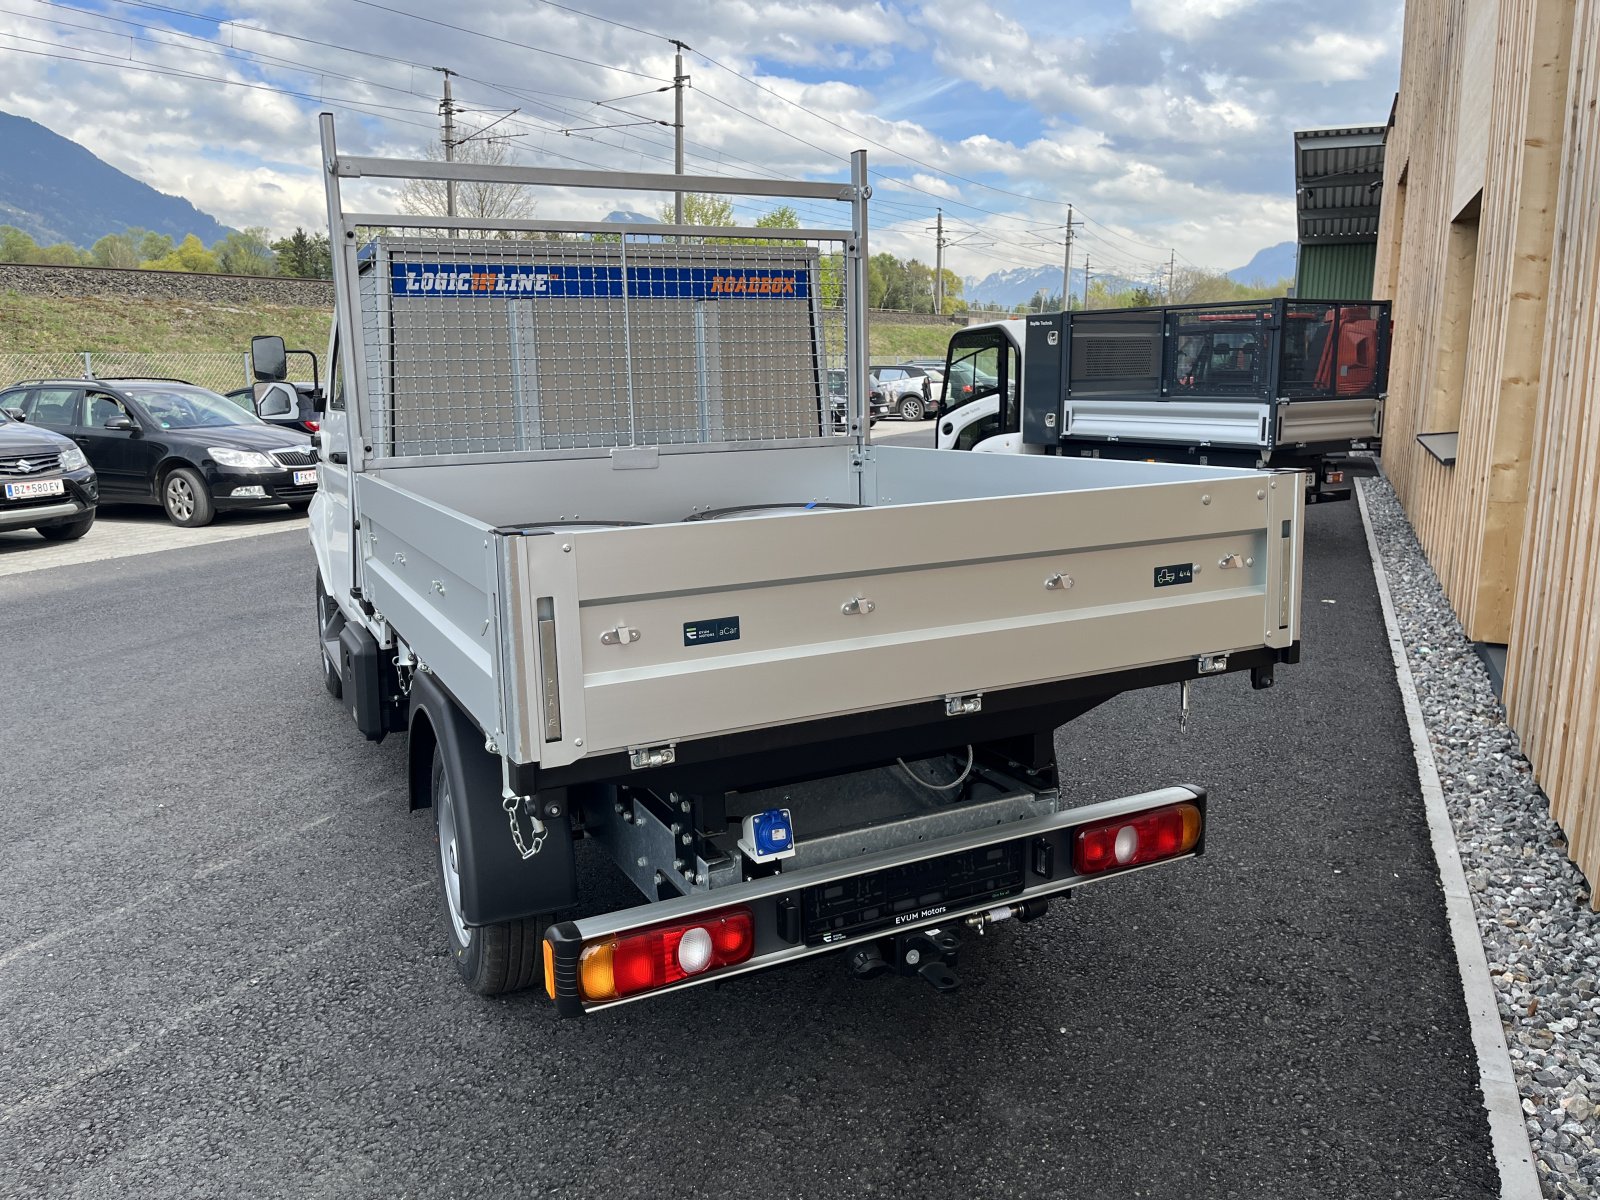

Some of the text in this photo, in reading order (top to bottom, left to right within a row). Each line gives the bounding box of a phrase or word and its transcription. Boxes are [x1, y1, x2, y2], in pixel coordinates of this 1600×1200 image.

[711, 276, 795, 293] ROADBOX
[14, 485, 26, 495] BZ
[719, 626, 738, 636] aCar
[895, 906, 947, 925] EVUM Motors
